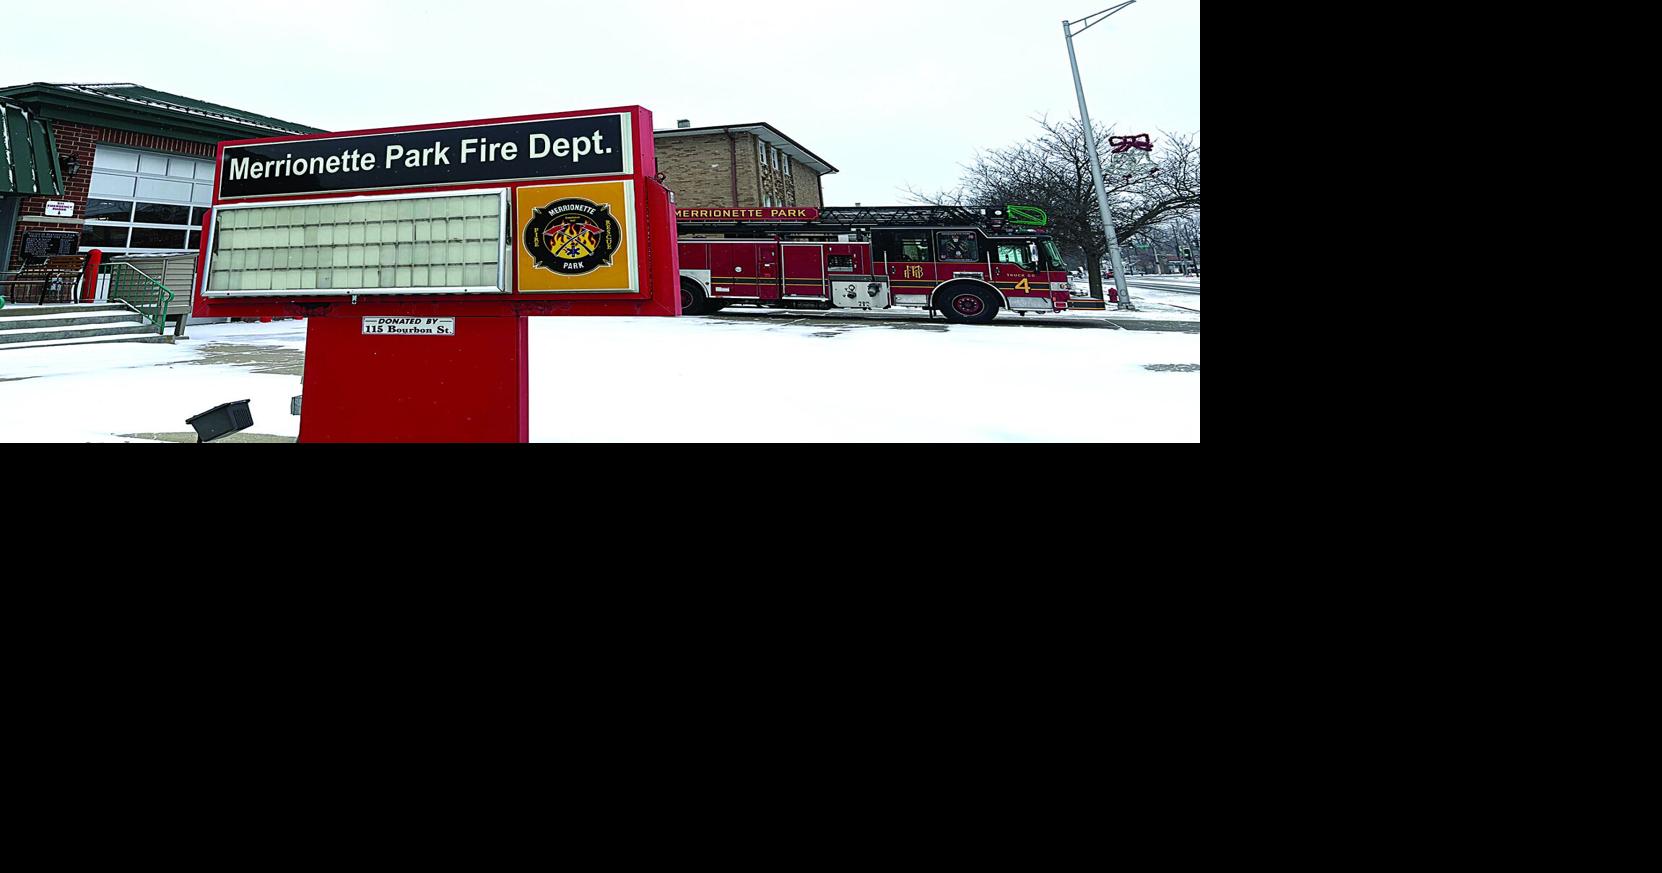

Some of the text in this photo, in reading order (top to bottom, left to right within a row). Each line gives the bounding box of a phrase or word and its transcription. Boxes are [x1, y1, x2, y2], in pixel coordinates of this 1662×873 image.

[229, 129, 612, 181] Merrionette Park Fire Dept.
[548, 204, 596, 216] MERRIONETTE
[771, 209, 806, 217] PARK
[563, 261, 584, 269] PARK
[1014, 277, 1030, 293] 4
[365, 325, 452, 334] 115 Bourbon St.
